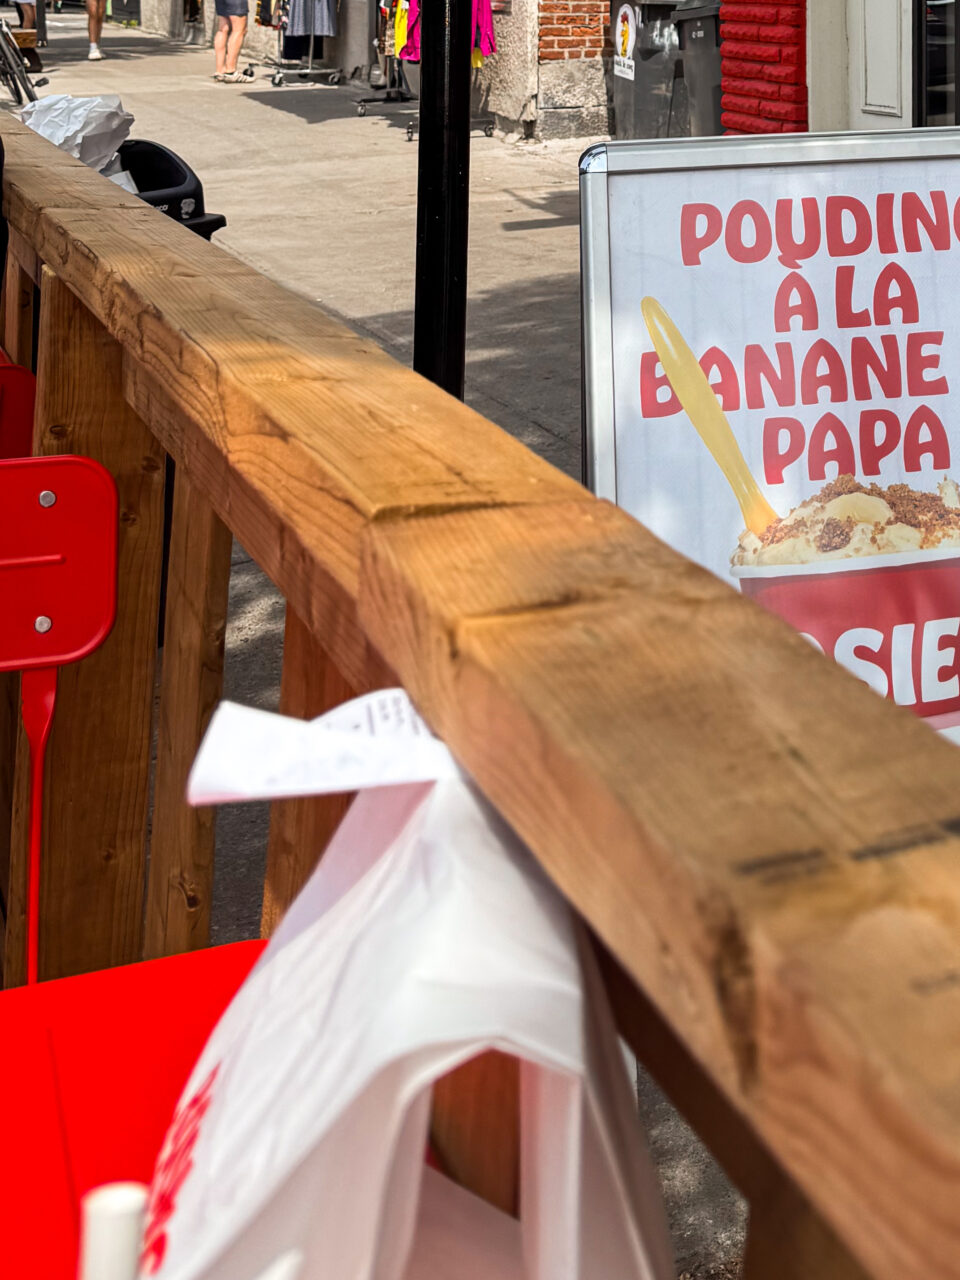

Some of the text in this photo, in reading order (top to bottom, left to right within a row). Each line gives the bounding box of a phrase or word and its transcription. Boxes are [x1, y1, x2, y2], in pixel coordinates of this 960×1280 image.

[835, 261, 920, 329] LA
[640, 330, 949, 419] BANANE
[762, 404, 951, 485] PAPA
